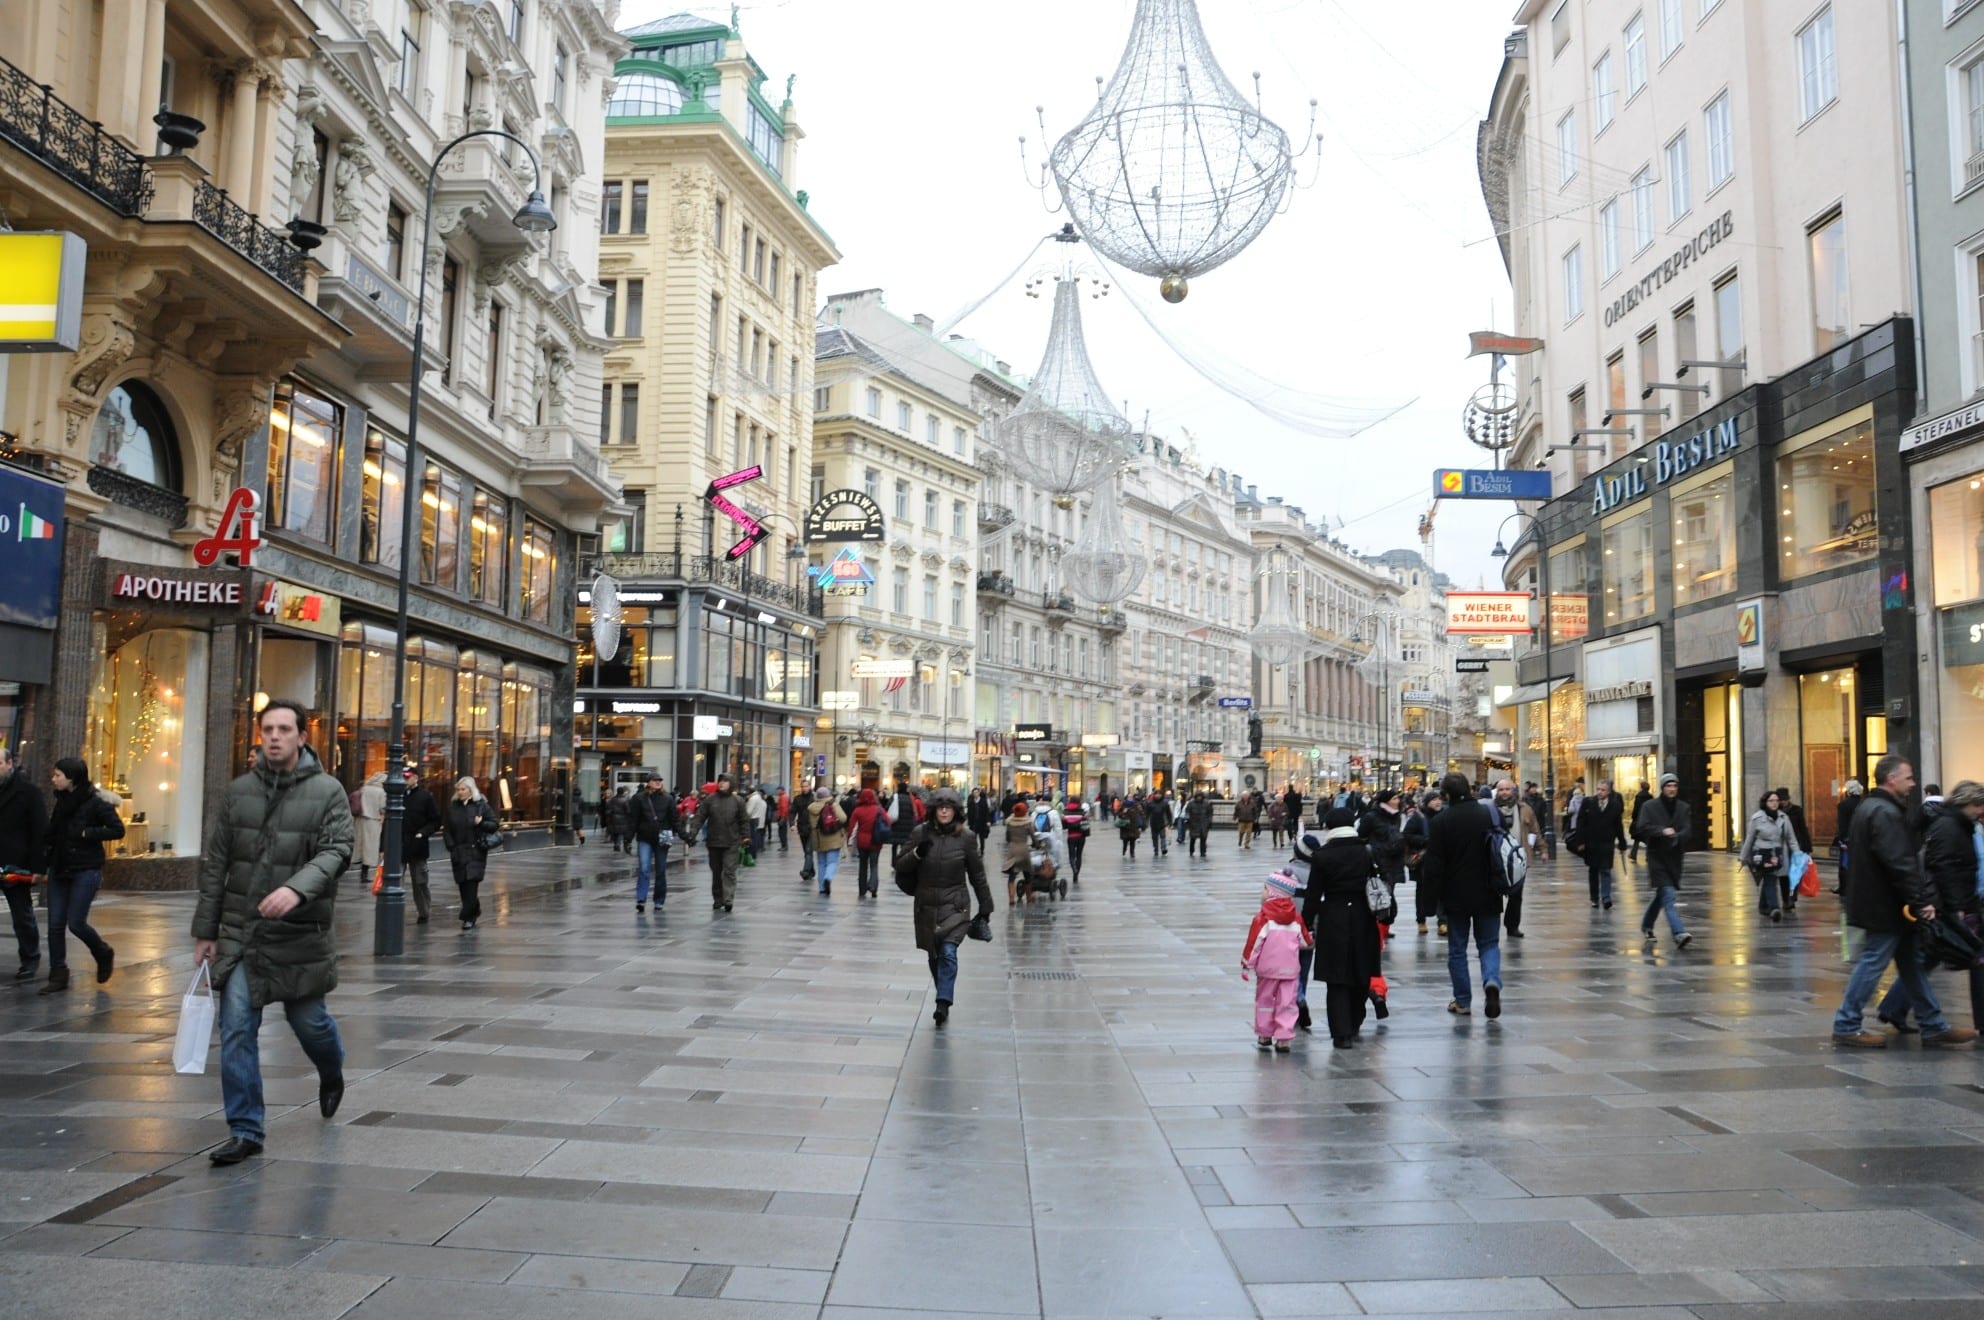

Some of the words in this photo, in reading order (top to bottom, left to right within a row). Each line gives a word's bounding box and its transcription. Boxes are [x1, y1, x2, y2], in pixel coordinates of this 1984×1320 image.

[1604, 209, 1734, 328] ORIENTTEPPICHE
[1914, 409, 1981, 444] STEFANEL
[822, 520, 868, 532] BUFFET
[114, 573, 242, 604] APOTHEKE
[1465, 603, 1513, 612] WIENER
